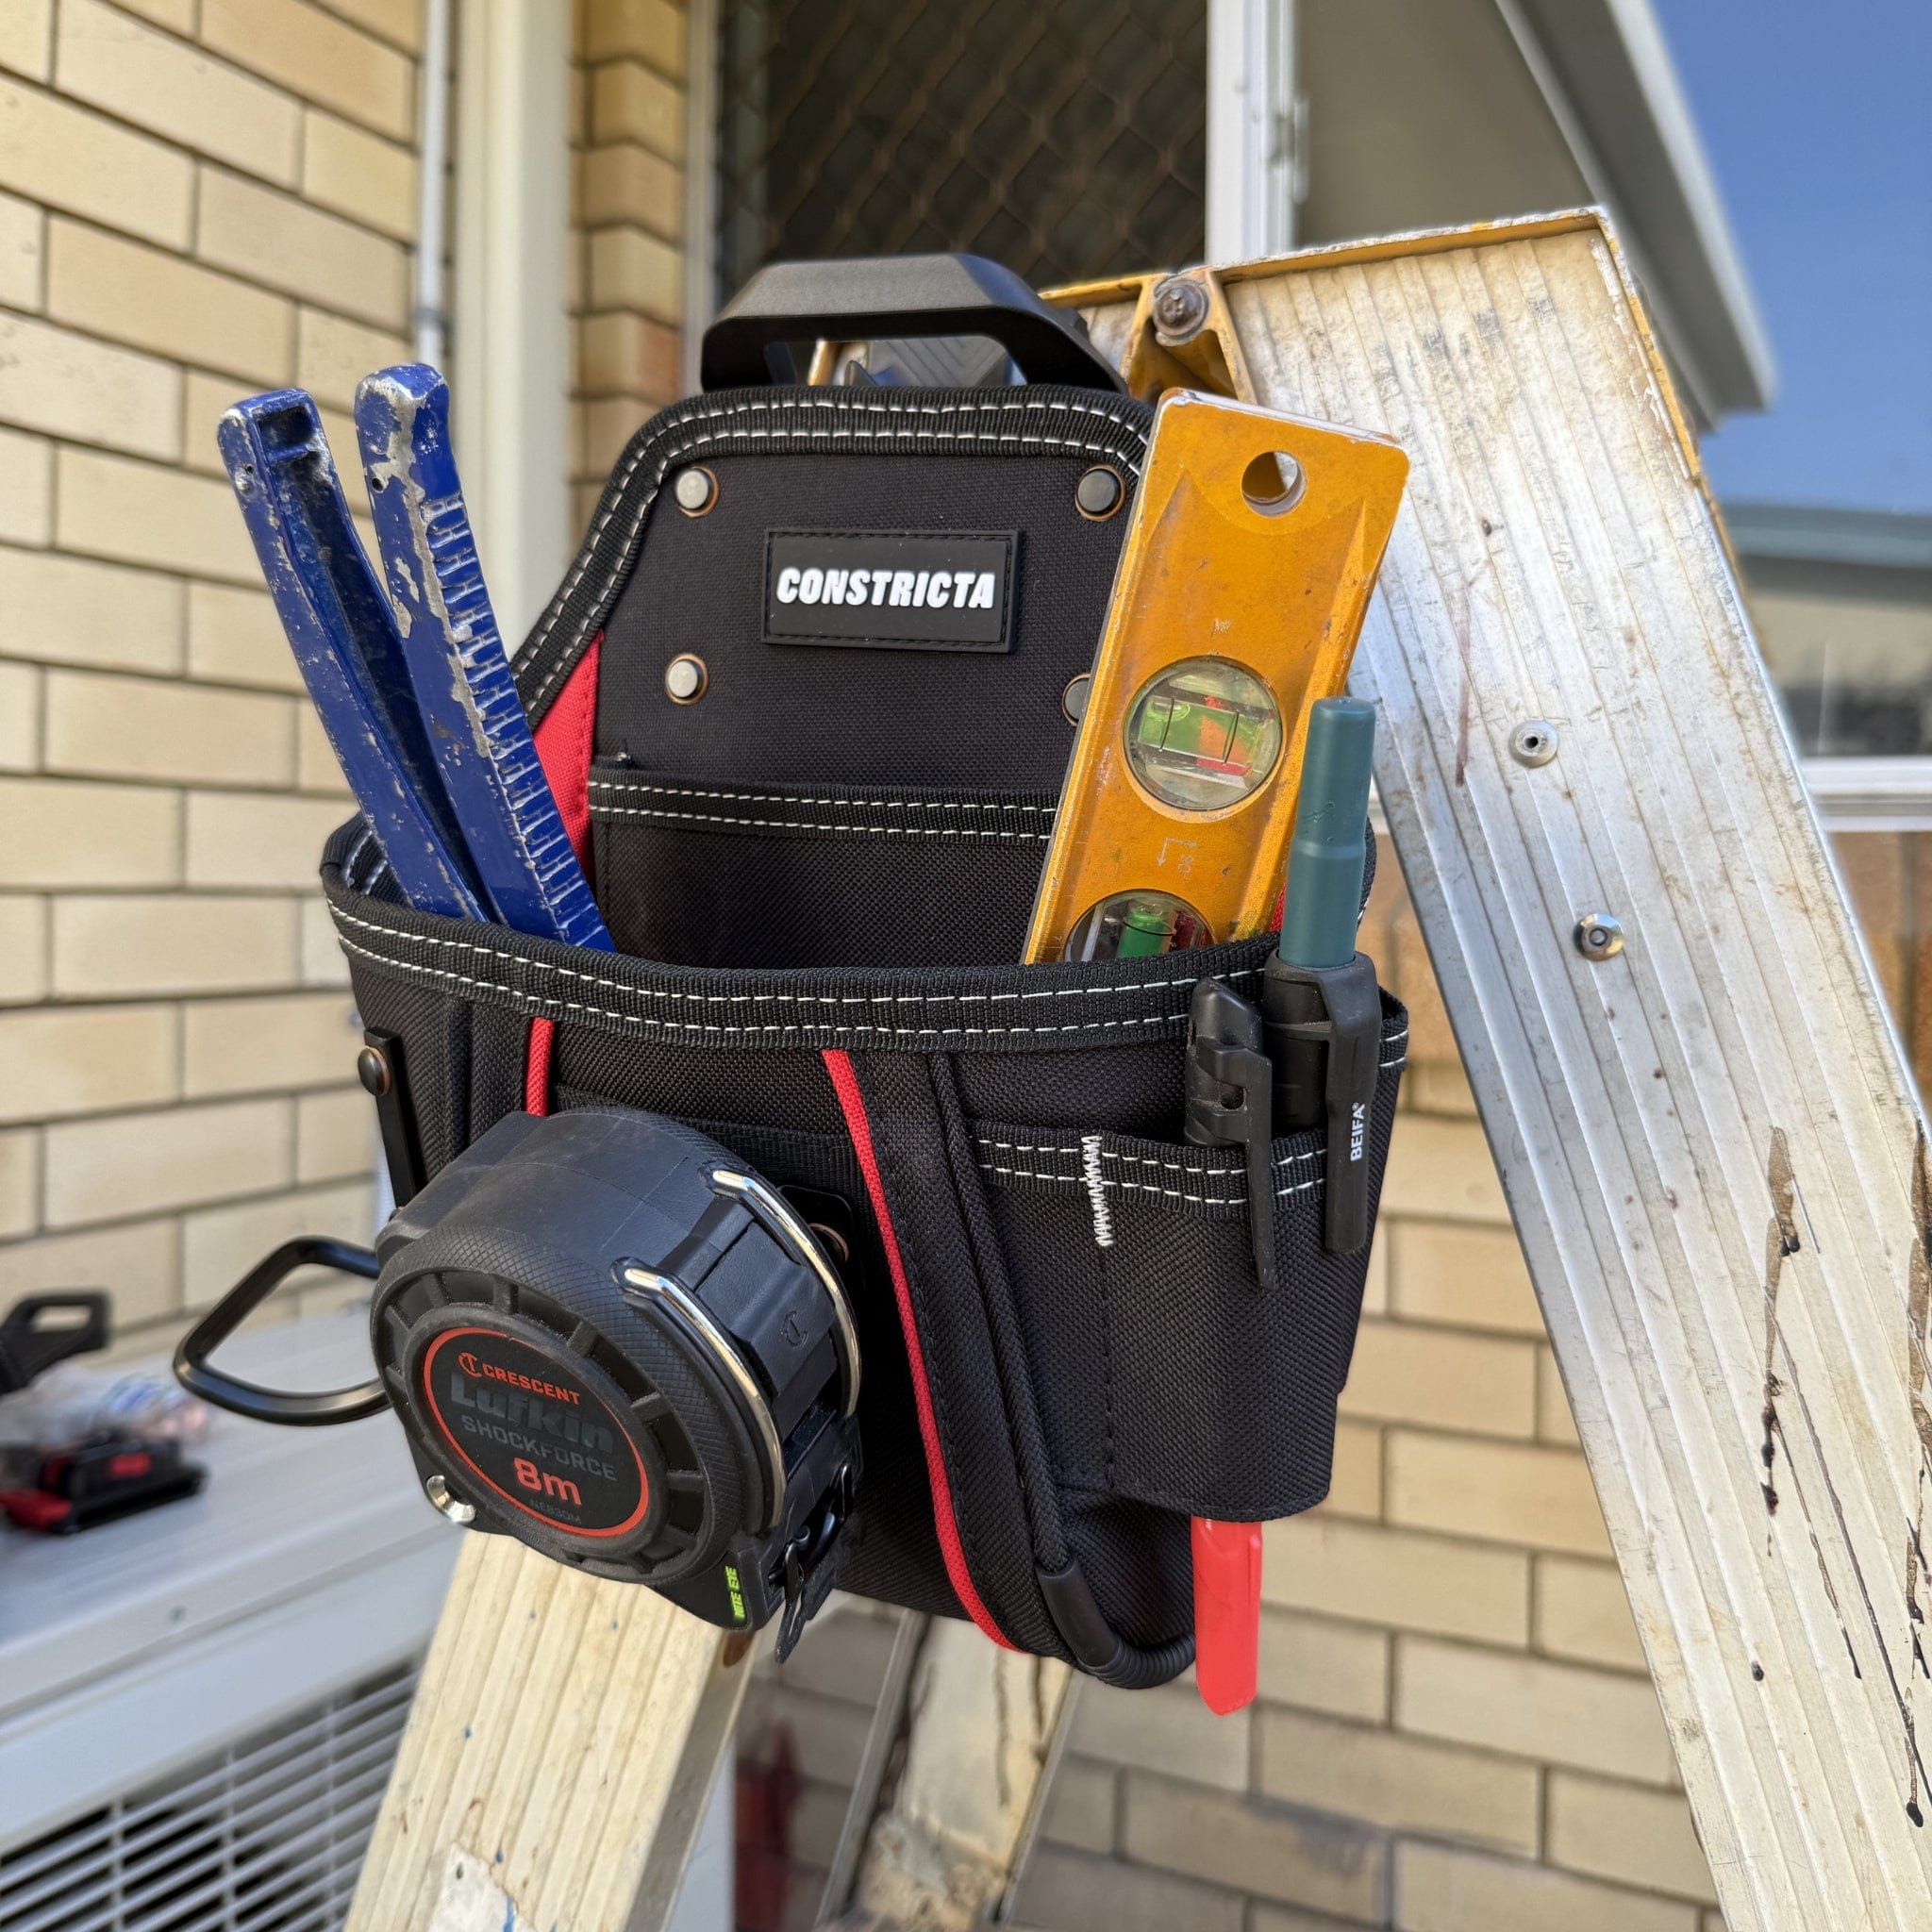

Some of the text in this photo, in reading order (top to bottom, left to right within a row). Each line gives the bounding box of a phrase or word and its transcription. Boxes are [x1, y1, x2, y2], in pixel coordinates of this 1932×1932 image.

[775, 567, 996, 609] CONSTRICTA
[482, 1363, 581, 1406] CRESCENT
[450, 1371, 614, 1454] Lufkin
[460, 1413, 618, 1482] SHOCKFORCE
[513, 1457, 582, 1506] 8m
